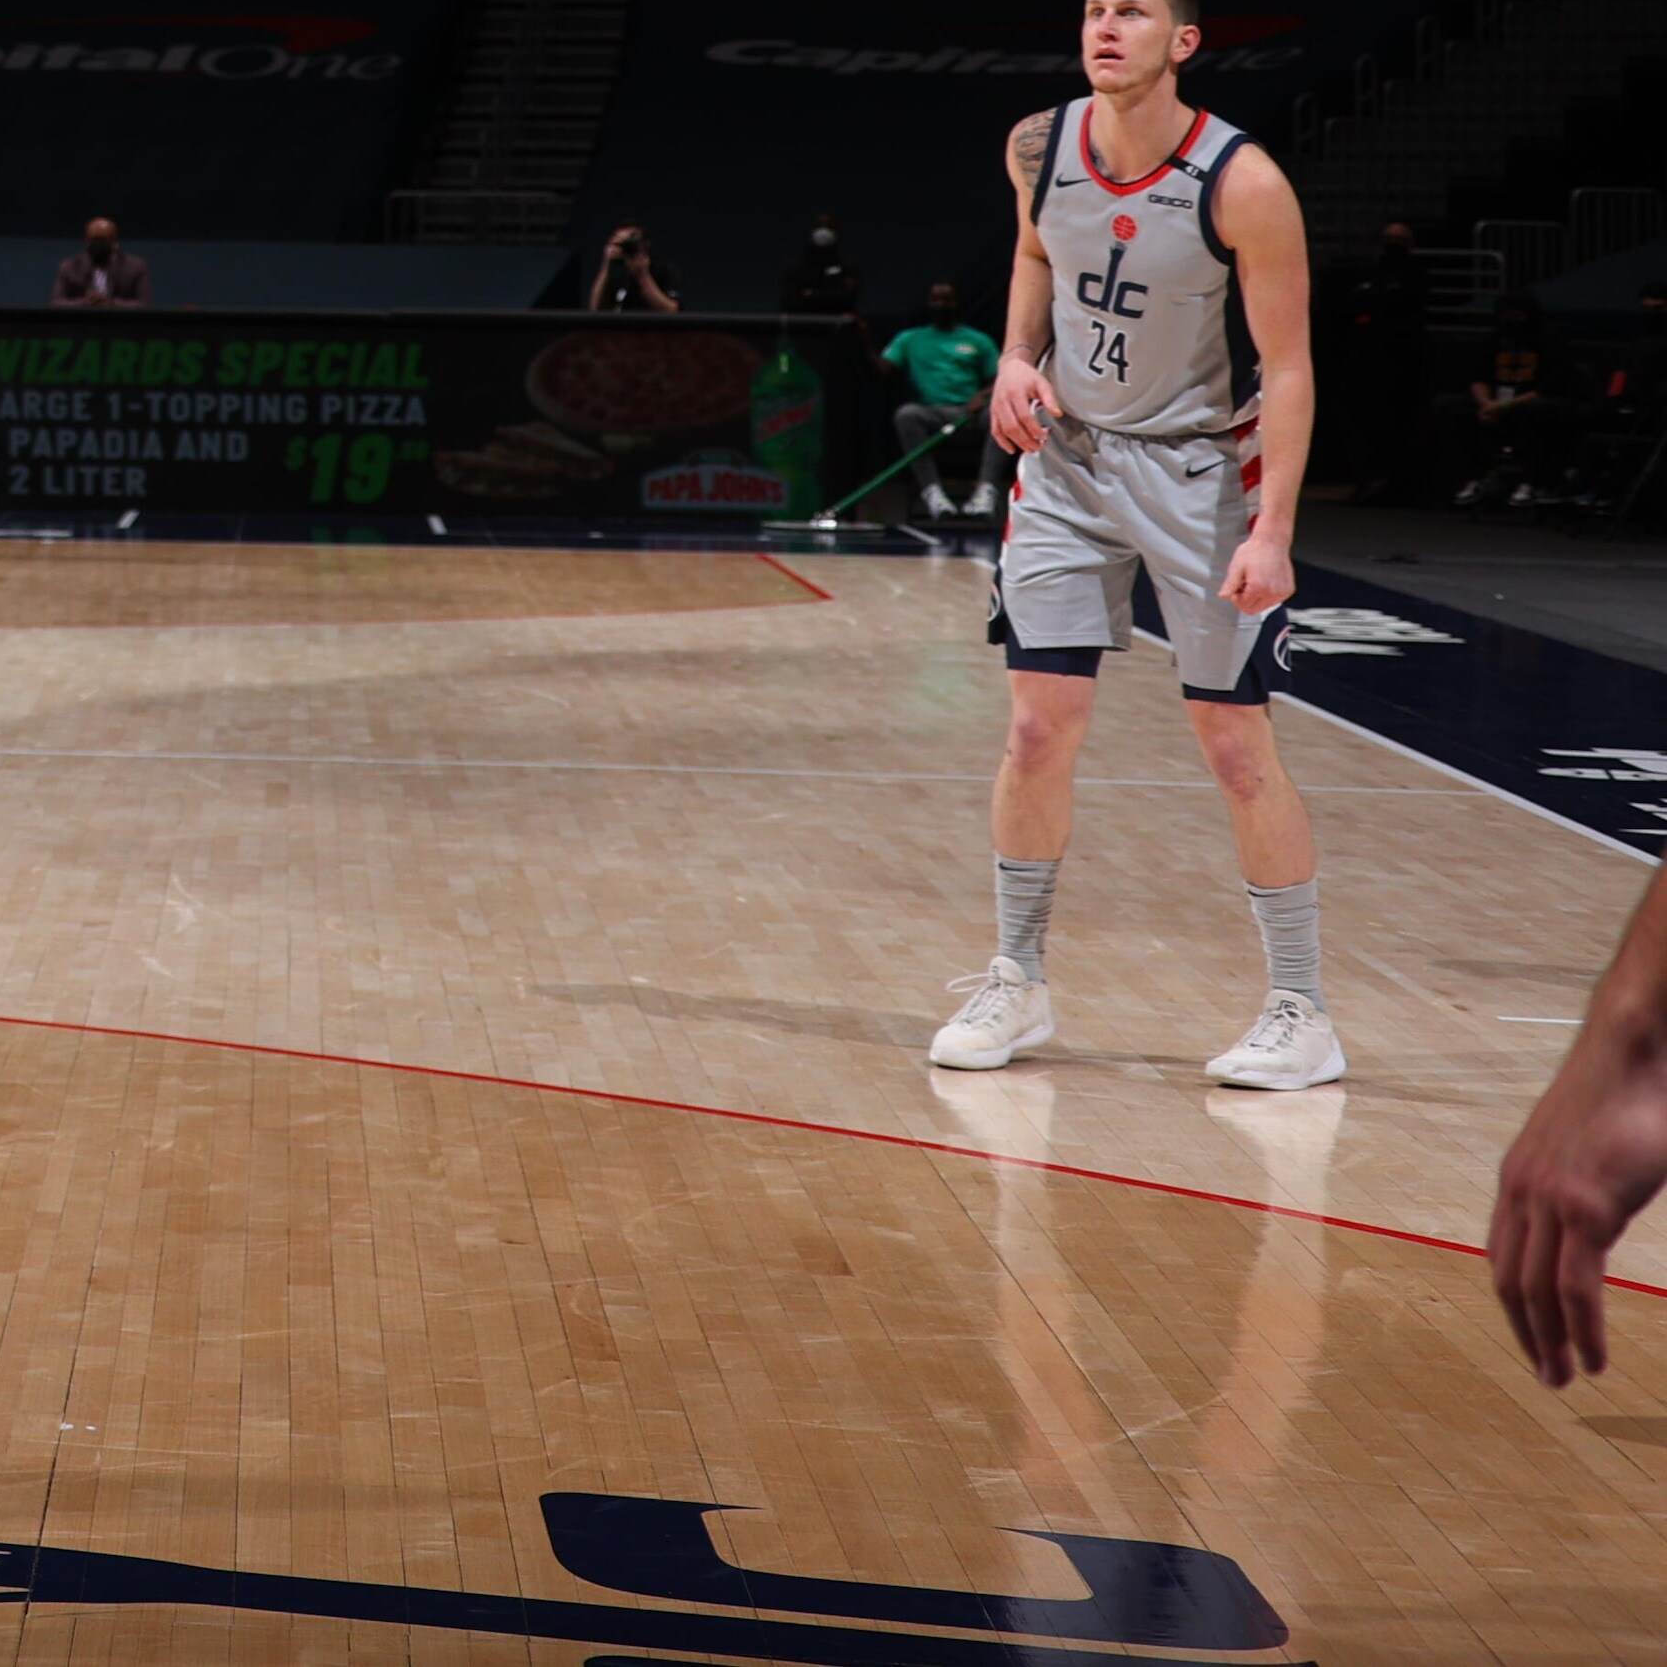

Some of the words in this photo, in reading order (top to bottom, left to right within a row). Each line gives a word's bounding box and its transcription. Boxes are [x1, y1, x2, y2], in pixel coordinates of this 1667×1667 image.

[1147, 194, 1194, 210] GEICO
[215, 342, 431, 390] SPECIAL
[1088, 321, 1130, 385] 24
[105, 392, 308, 426] 1-TOPPING
[320, 395, 427, 428] PIZZA
[8, 429, 166, 462] PAPADIA
[174, 431, 251, 463] AND
[8, 466, 31, 497] 2
[43, 467, 147, 498] LITER
